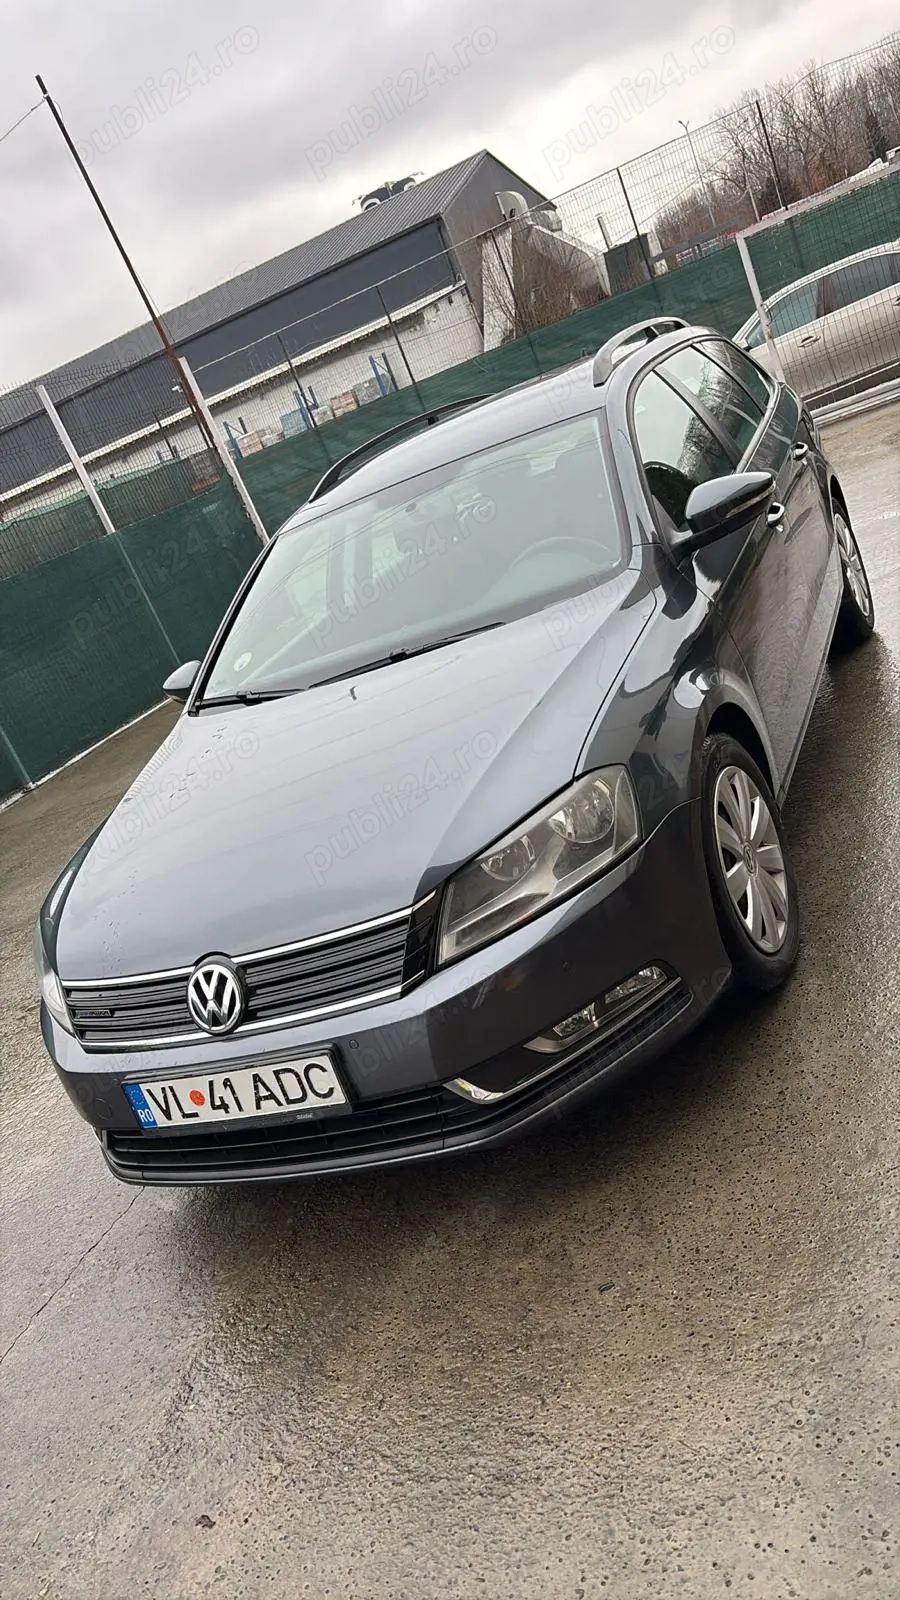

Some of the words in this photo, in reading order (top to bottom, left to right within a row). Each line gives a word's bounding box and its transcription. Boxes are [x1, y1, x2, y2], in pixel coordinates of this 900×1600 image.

[146, 1085, 199, 1121] VL
[207, 1077, 244, 1114] 41
[252, 1062, 335, 1110] ADC
[138, 1109, 153, 1123] RO
